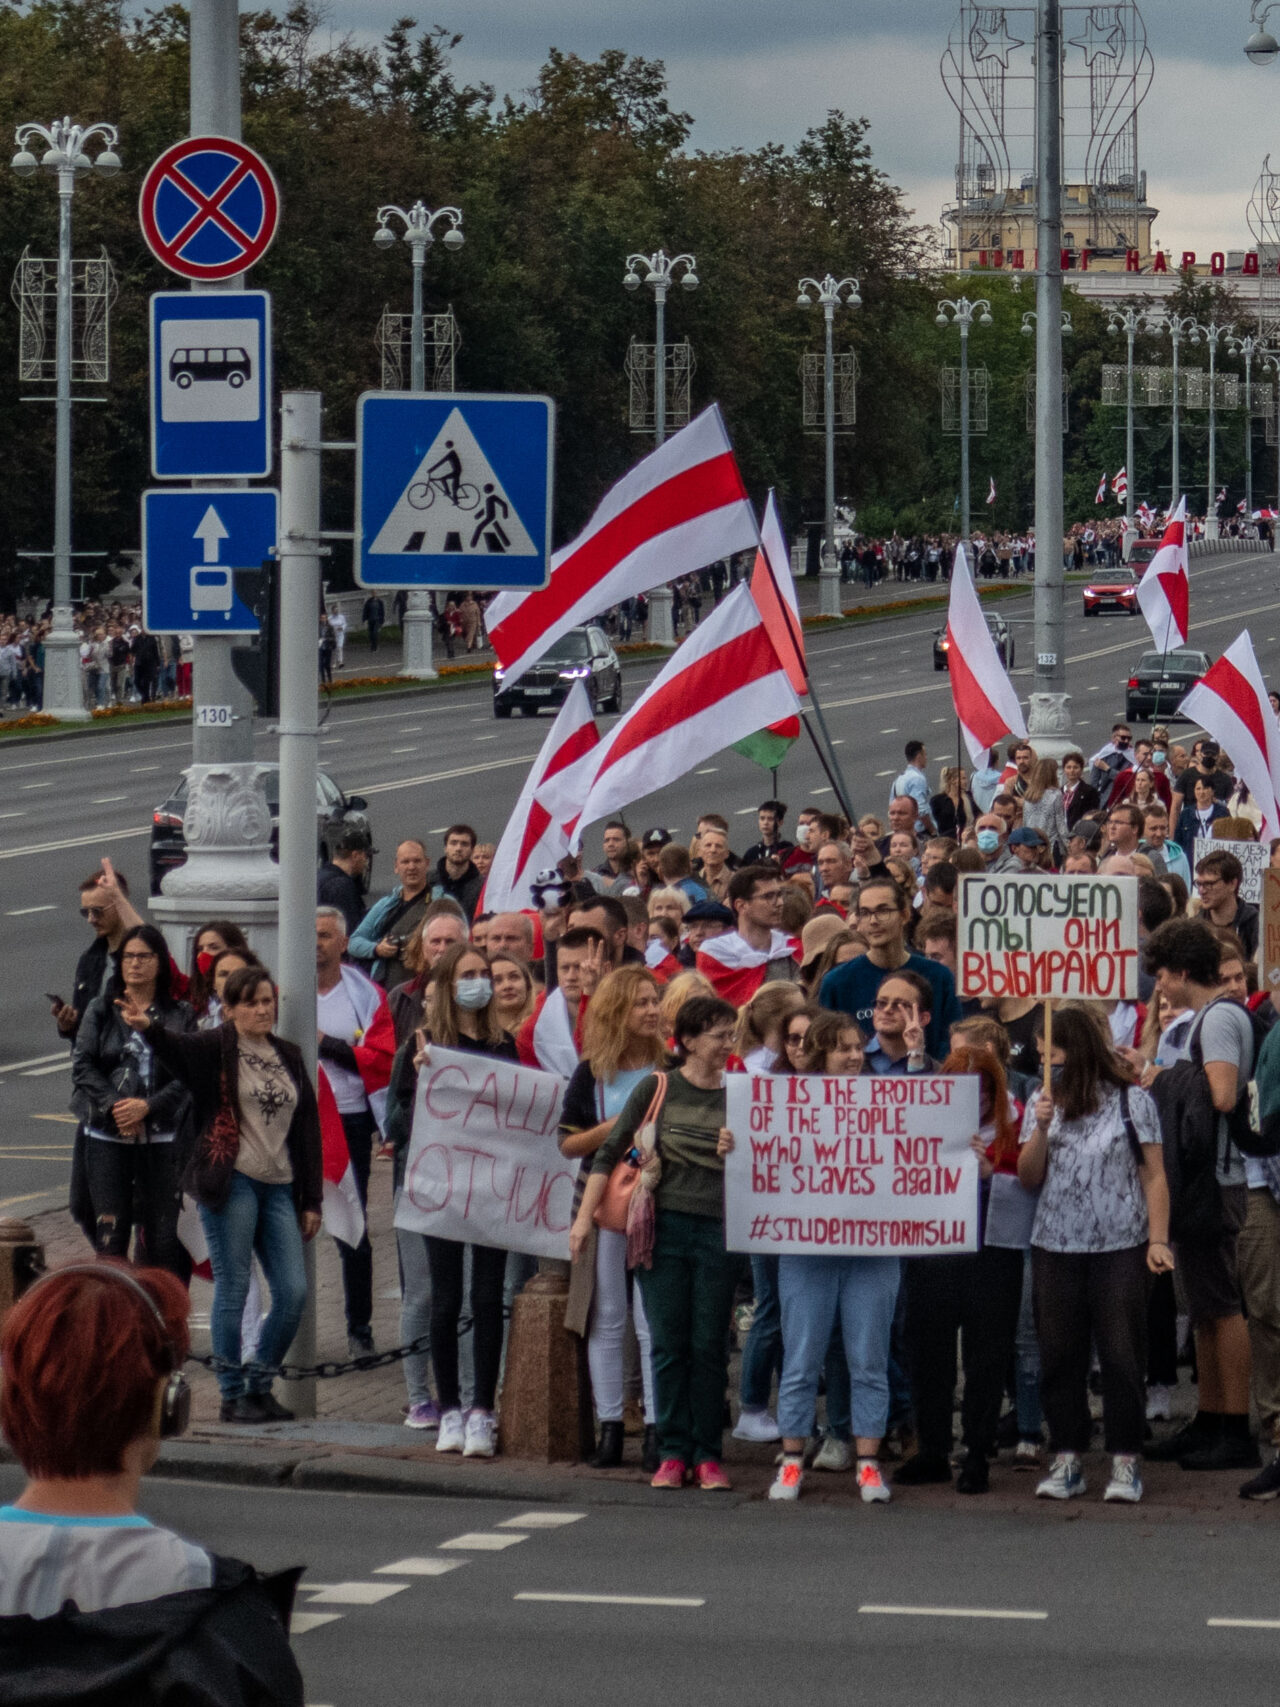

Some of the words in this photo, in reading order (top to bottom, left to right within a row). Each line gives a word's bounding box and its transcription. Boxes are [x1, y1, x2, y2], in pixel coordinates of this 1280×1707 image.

[1040, 655, 1055, 663] 132
[201, 709, 227, 723] 130
[963, 877, 1123, 920] ГОЛОСУЕМ
[1063, 917, 1121, 950] ОНИ
[961, 949, 1138, 999] ВЫБИРАЮТ
[425, 1064, 560, 1137] САШ
[786, 1075, 811, 1105] IS
[870, 1079, 955, 1106] PROTEST
[750, 1106, 774, 1132] OF
[834, 1107, 908, 1135] PEOPLE
[813, 1136, 884, 1166] WILL
[893, 1137, 943, 1165] NOT
